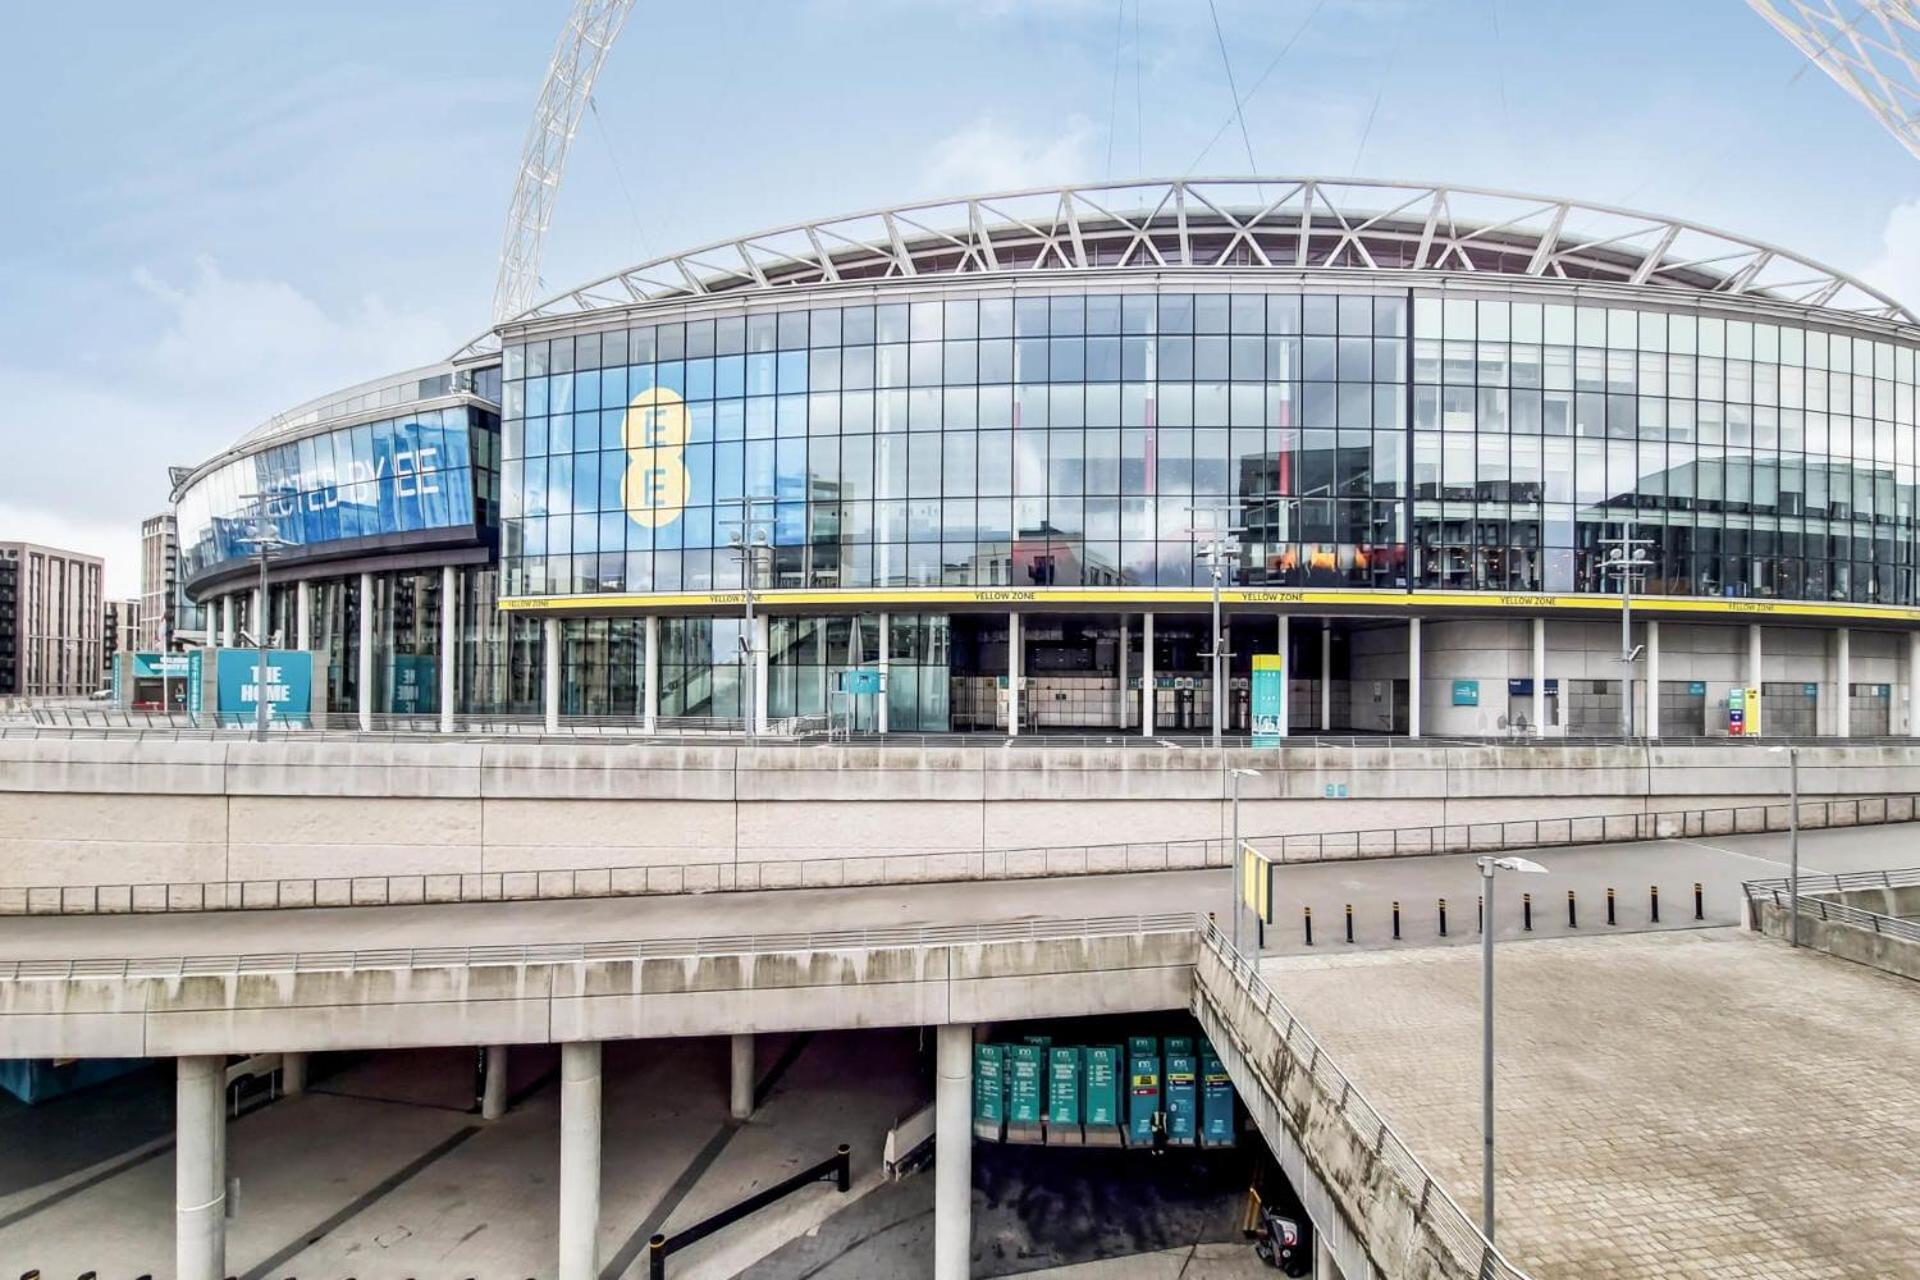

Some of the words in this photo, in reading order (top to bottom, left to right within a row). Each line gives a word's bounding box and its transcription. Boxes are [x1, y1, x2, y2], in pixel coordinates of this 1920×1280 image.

[221, 468, 338, 532] COECTED
[348, 456, 385, 503] BY
[395, 448, 439, 497] EE
[709, 594, 740, 603] YELLOW
[741, 594, 762, 602] ZNE
[974, 591, 1010, 600] YELLOW
[1011, 591, 1035, 600] ZONE
[1242, 593, 1278, 601] YELLOW
[1279, 593, 1304, 601] ZONE
[508, 600, 532, 608] YELLOW
[1500, 597, 1534, 605] YELLOW
[1535, 597, 1556, 606] ZONE
[1728, 602, 1757, 611] YELLOW
[1757, 603, 1775, 612] ZONE
[255, 704, 277, 720] F
